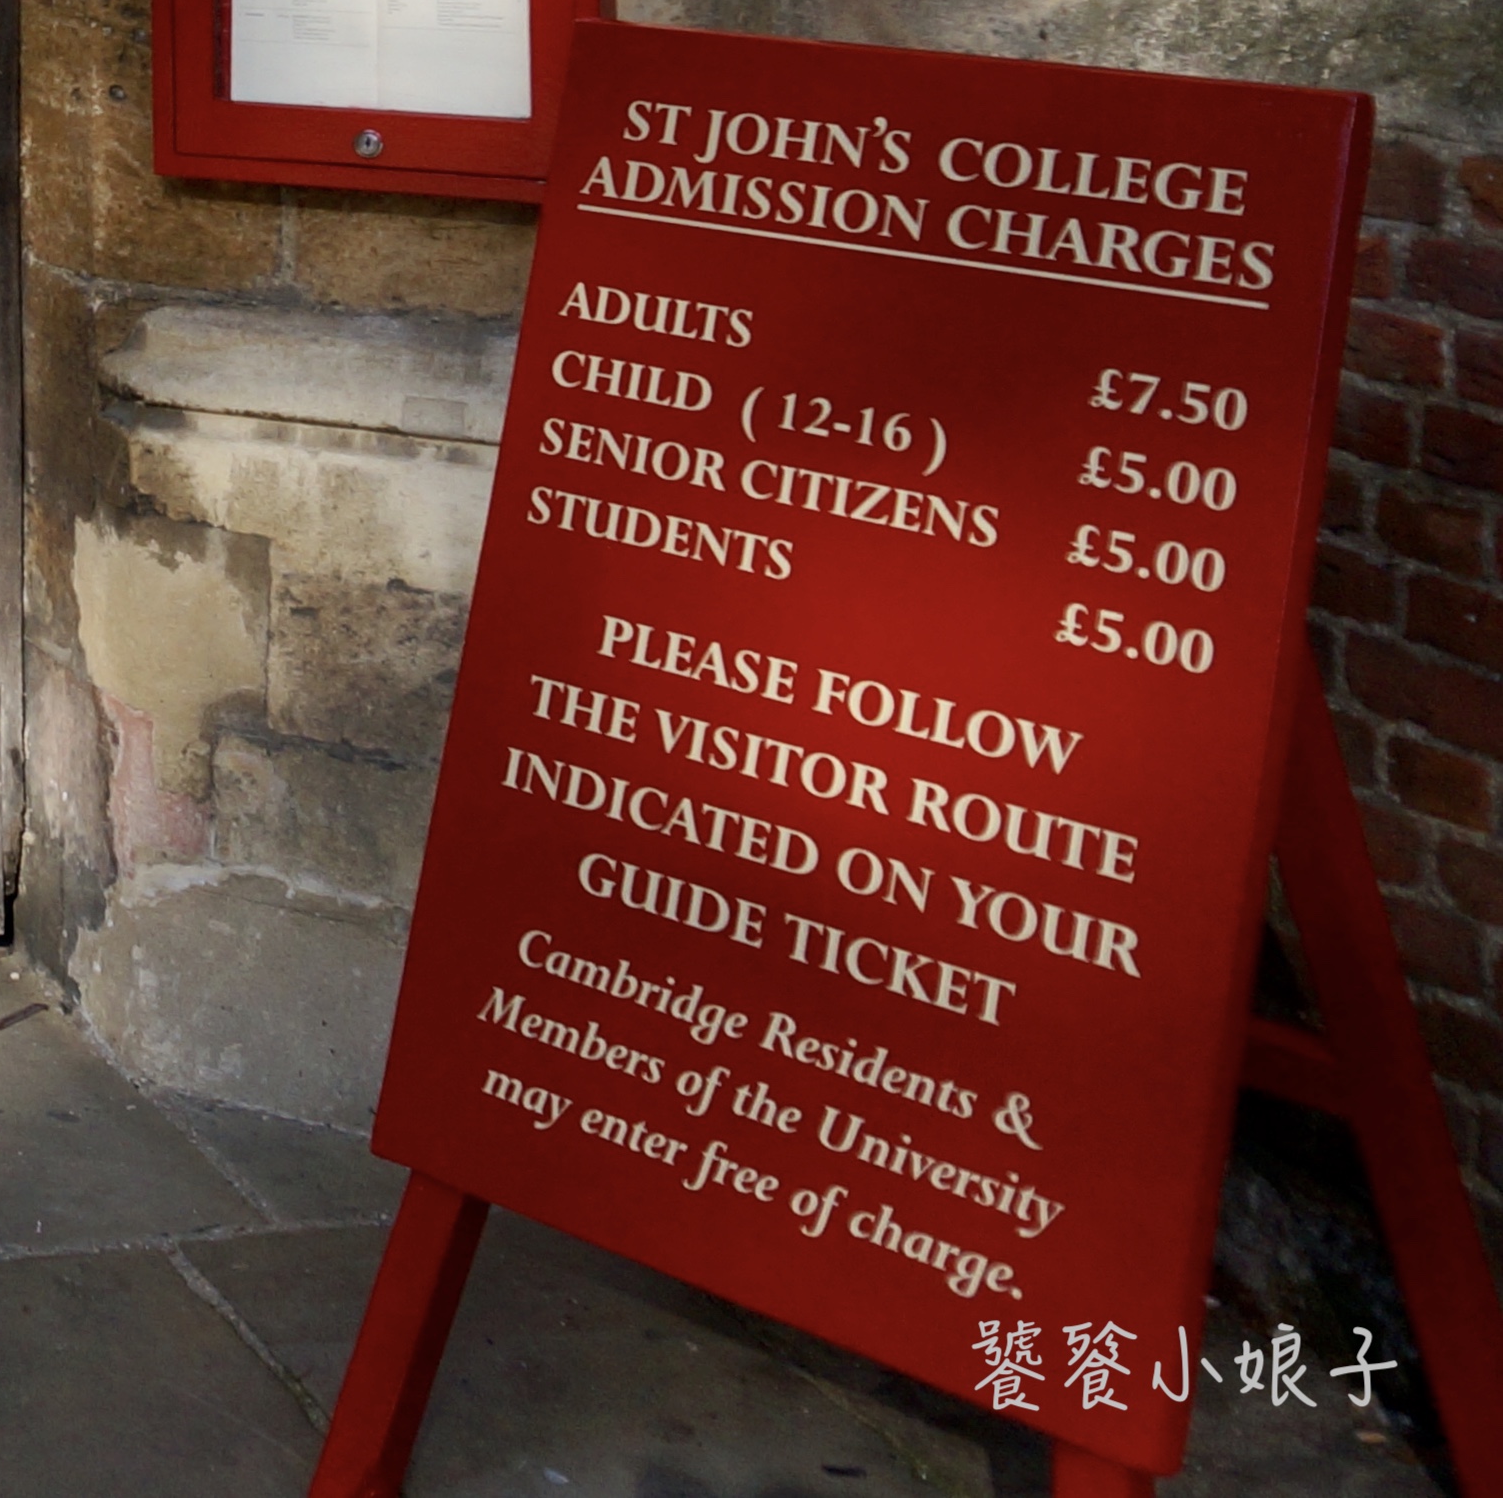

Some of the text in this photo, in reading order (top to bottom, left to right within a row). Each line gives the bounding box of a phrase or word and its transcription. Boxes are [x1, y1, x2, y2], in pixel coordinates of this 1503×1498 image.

[624, 101, 1247, 215] ST JOHN'S COLLEGE
[581, 157, 1273, 289] ADMISSION CHARGES
[560, 283, 752, 347] ADULTS
[553, 351, 712, 410] CHILD
[1091, 369, 1247, 430] £7.50
[528, 487, 792, 579] STUDENTS
[540, 418, 998, 547] SENIOR CITIZENS
[1079, 447, 1236, 510] £5.00
[1067, 525, 1225, 591] £5.00
[599, 616, 1083, 774] PLEASE FOLLOW
[1055, 603, 1213, 673] £5.00
[532, 675, 1137, 883] THE VISITOR ROUTE
[504, 748, 1139, 977] INDICATED ON YOUR
[580, 854, 1016, 1024] GUIDE TICKET
[520, 931, 1040, 1149] Cambridge Residents &
[478, 988, 1063, 1237] Members of the University
[484, 1071, 1022, 1299] may enter free of charge.
